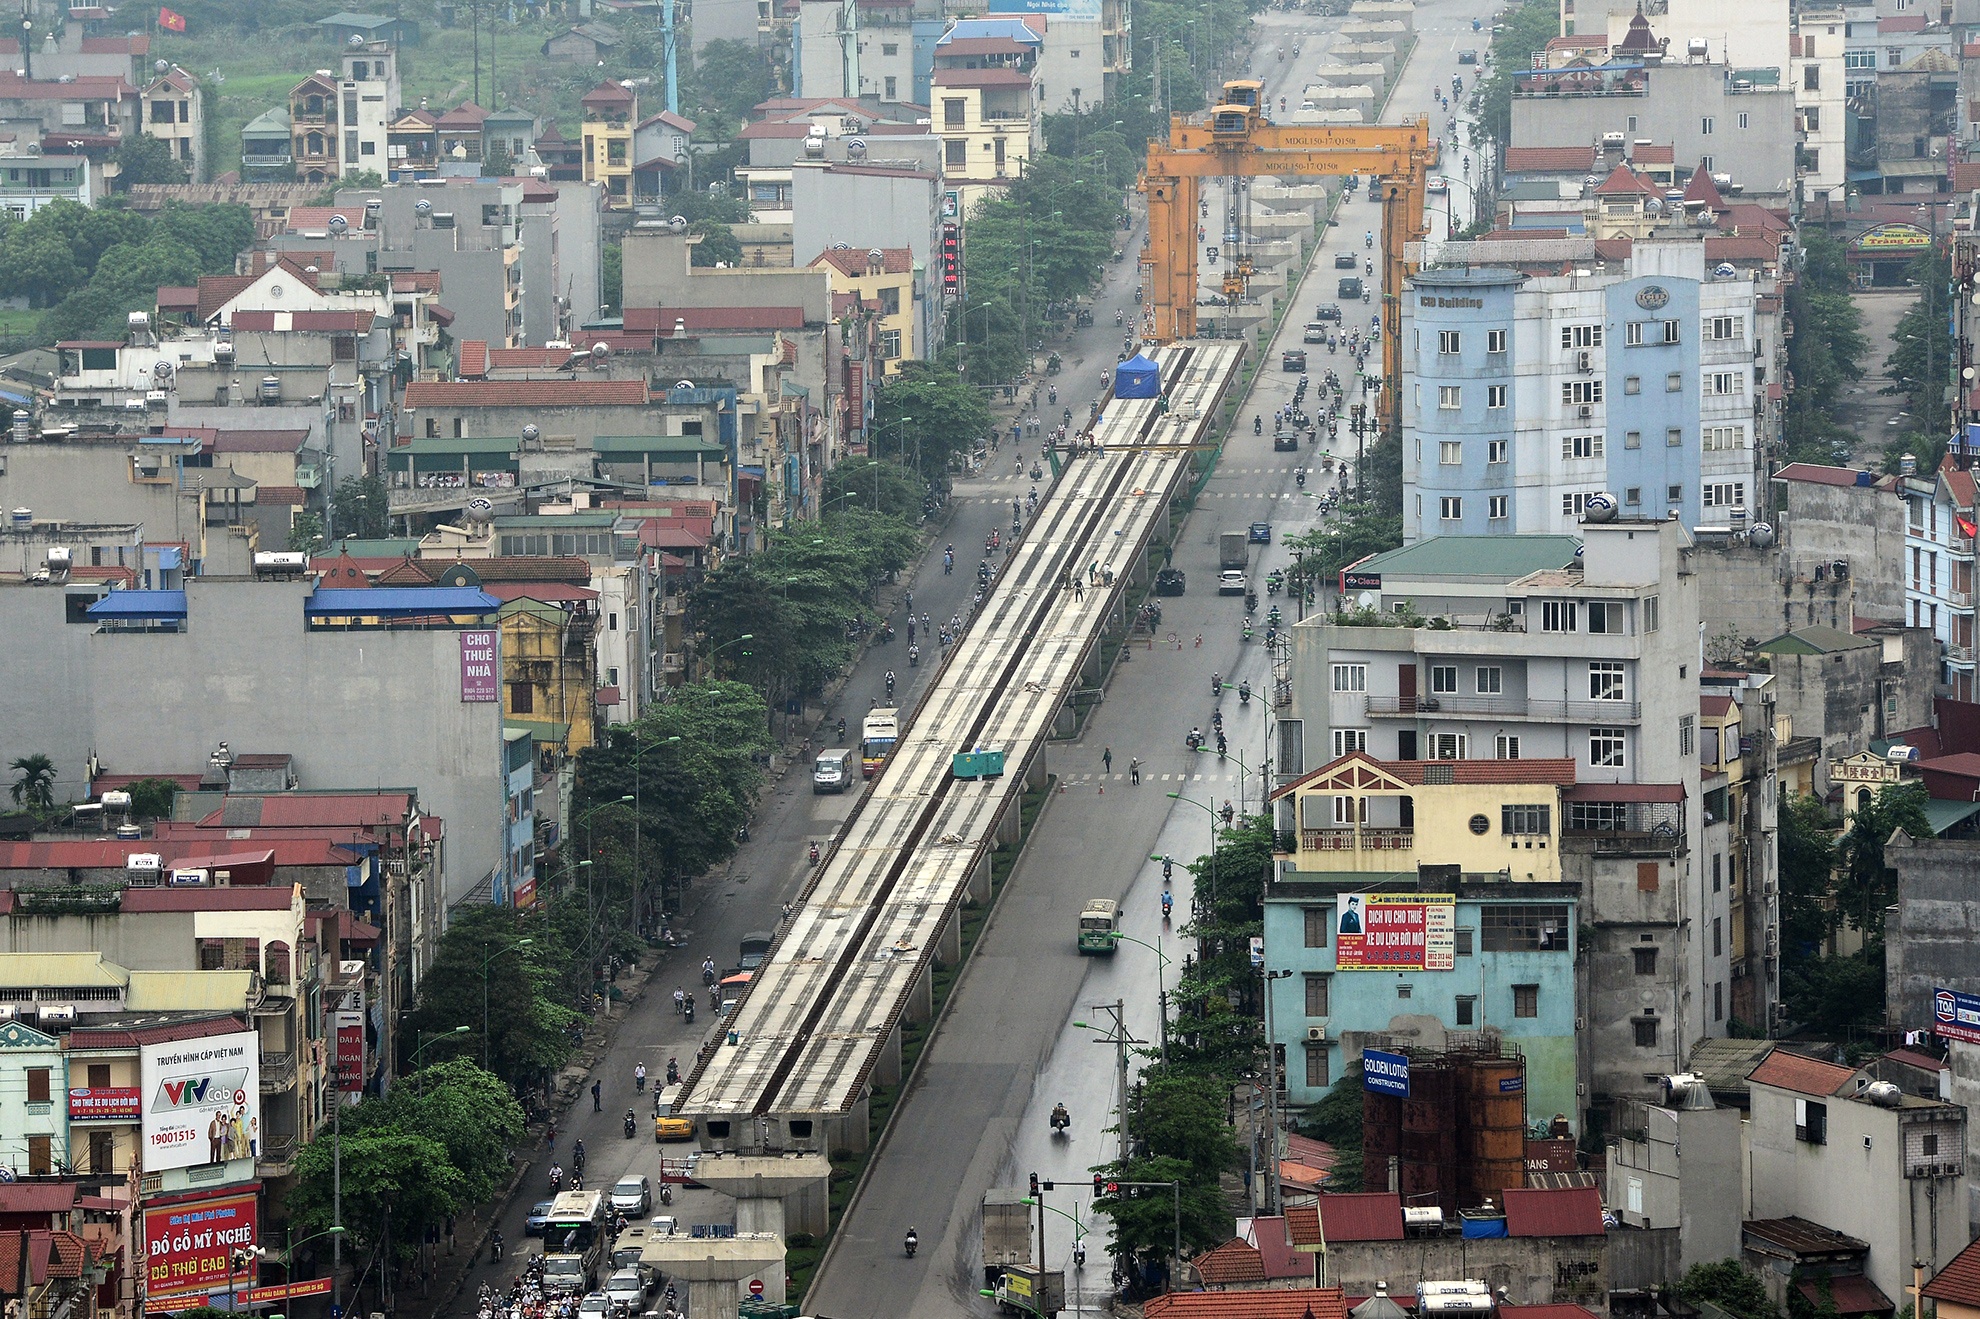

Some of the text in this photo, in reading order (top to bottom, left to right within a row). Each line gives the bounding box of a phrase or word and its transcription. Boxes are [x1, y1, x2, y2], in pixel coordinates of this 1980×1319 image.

[1438, 296, 1483, 310] Building
[466, 634, 490, 646] CHO
[464, 648, 493, 661] THUÊ
[466, 664, 491, 676] NHÀ
[1368, 907, 1422, 926] DỊCH VỤ CHO THUÊ
[1366, 928, 1424, 948] XE DU LỊCH ĐỜI MỚI
[1938, 1000, 1954, 1014] TOA
[339, 1036, 353, 1045] ĐẠI
[156, 1047, 244, 1066] TRUYỀN HÌNH CÁP VIỆT NAM
[1364, 1058, 1408, 1079] GOLDEN LOTUS
[1367, 1076, 1406, 1090] CONSTRUCTION
[72, 1098, 82, 1107] CHO
[82, 1097, 94, 1107] THUÊ
[94, 1098, 101, 1107] XE
[102, 1098, 108, 1107] DU
[109, 1098, 119, 1108] LỊCH
[150, 1129, 196, 1145] 19001515
[1527, 1160, 1549, 1170] ANS
[1107, 1183, 1118, 1192] 03
[170, 1216, 182, 1226] Siêu
[192, 1213, 204, 1222] Mini
[151, 1222, 252, 1256] ĐỒ GỖ MỸ NGHỆ
[151, 1258, 169, 1280] ĐỒ
[201, 1256, 226, 1273] CAO
